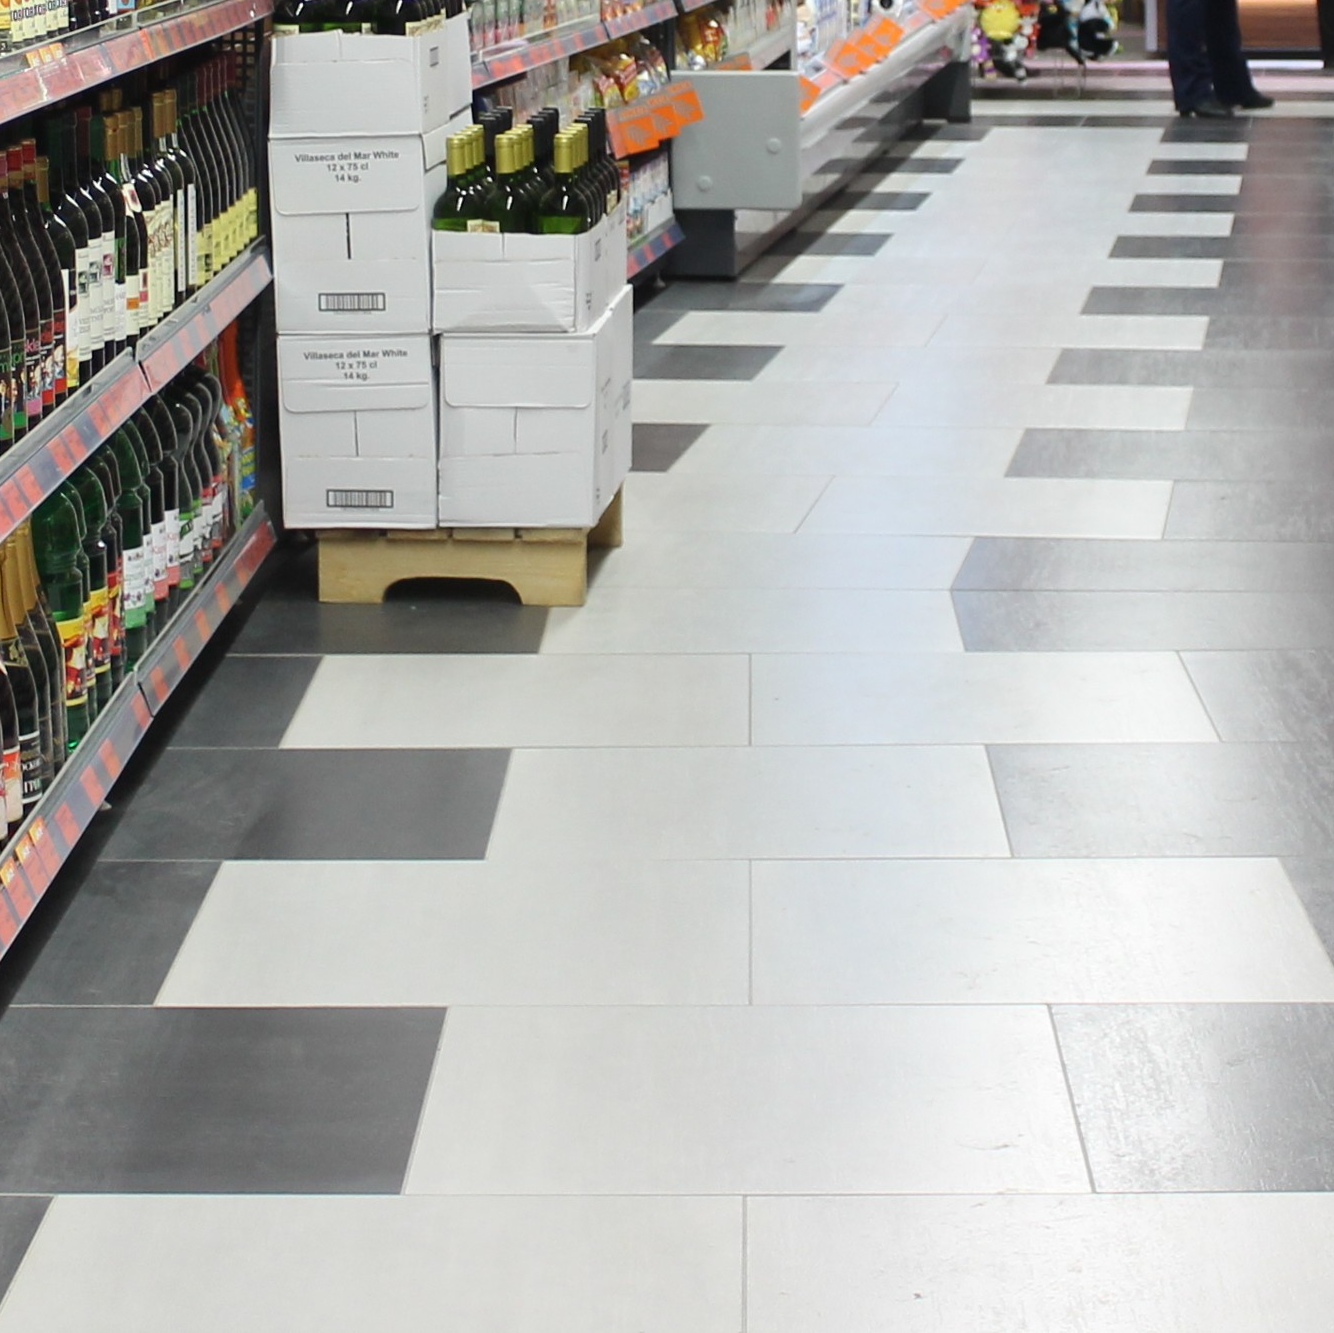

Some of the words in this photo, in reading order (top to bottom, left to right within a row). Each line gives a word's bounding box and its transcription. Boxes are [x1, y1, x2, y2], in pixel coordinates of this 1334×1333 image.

[294, 153, 336, 163] Villaseca
[338, 153, 351, 161] del
[354, 152, 371, 161] Mar
[373, 151, 400, 160] White
[327, 164, 337, 172] 12
[347, 163, 358, 171] 75
[335, 174, 345, 182] 14
[303, 352, 344, 361] Villaseca
[346, 350, 360, 359] del
[363, 350, 380, 358] Mar
[381, 349, 408, 358] White
[336, 362, 346, 370] 12
[356, 361, 368, 369] 75
